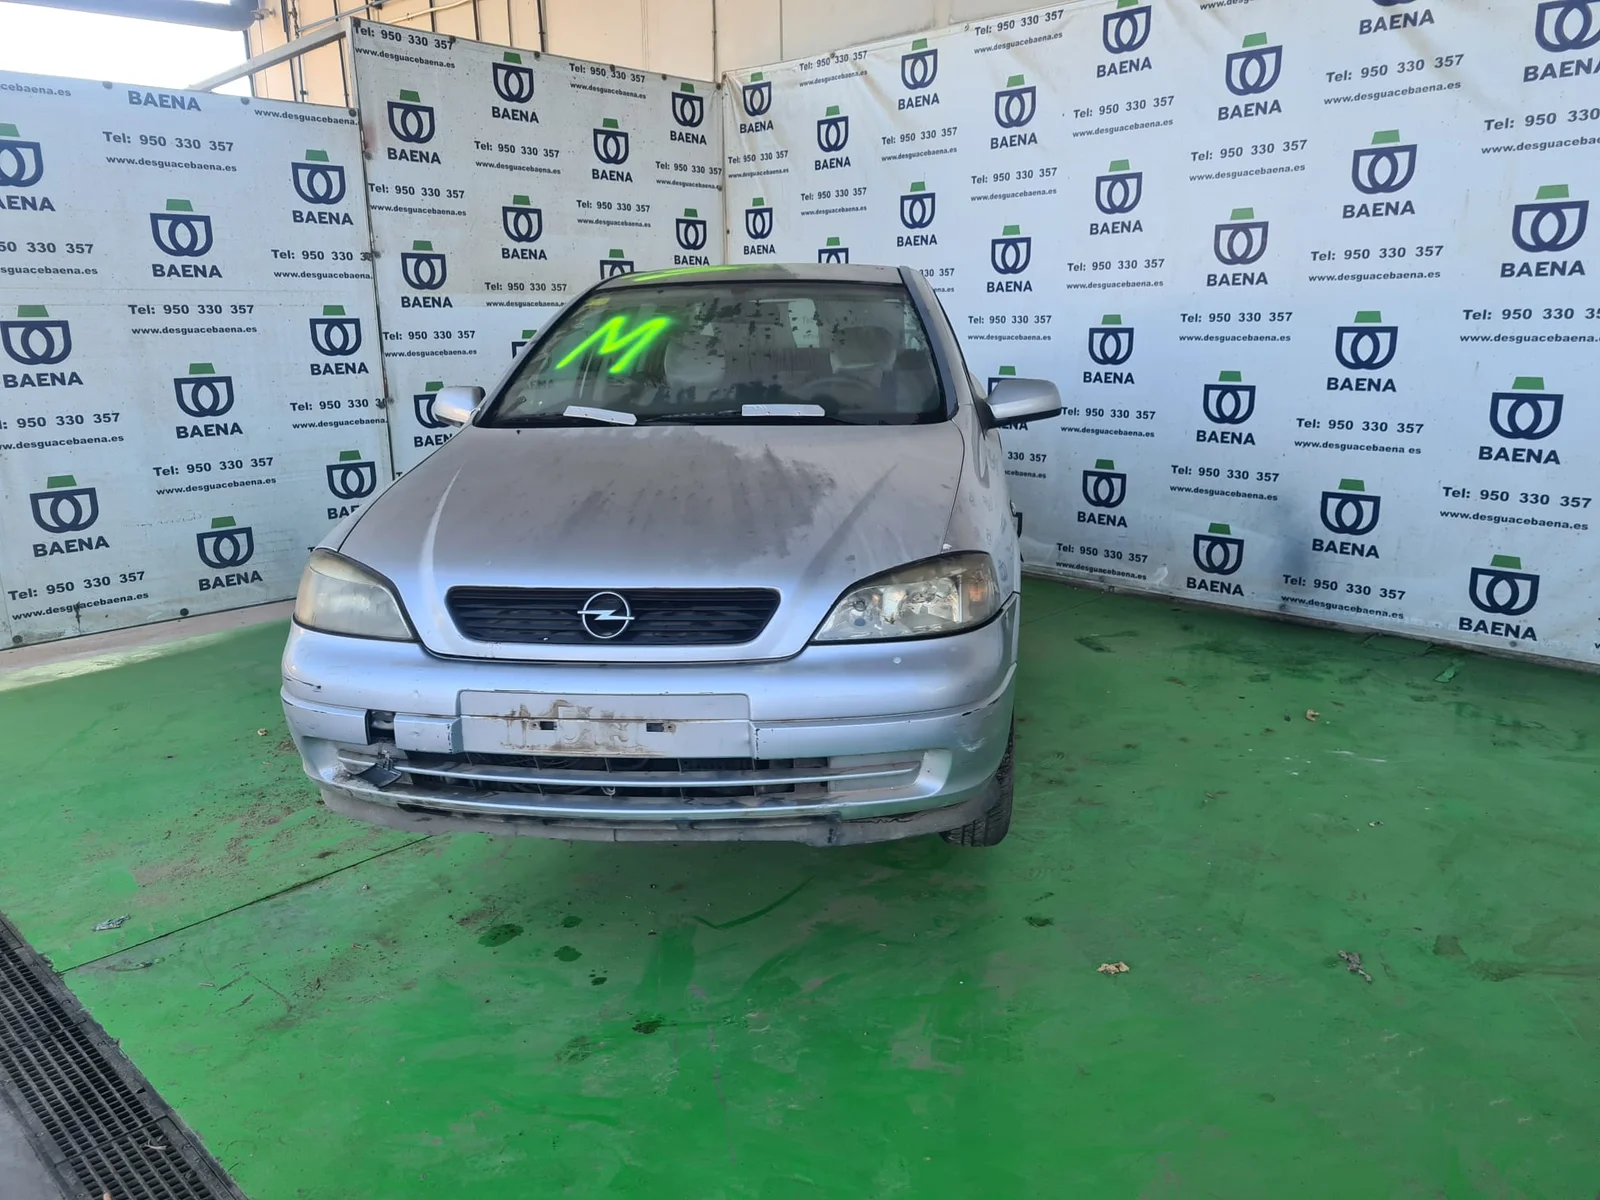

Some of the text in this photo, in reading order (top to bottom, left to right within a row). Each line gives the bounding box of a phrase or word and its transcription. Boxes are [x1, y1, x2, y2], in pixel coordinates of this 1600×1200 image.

[974, 9, 1064, 36] Tel: 950 330 357
[1359, 9, 1435, 35] BAENA
[974, 32, 1063, 54] www.desguacebaena.es
[355, 46, 456, 69] www.desguacebaena.es
[1097, 56, 1152, 78] BAENA
[1326, 54, 1464, 83] Tel: 950 330 357
[128, 90, 202, 112] BAENA
[1324, 82, 1461, 105] www.desguacebaena.es
[898, 93, 940, 111] BAENA
[1073, 95, 1174, 119] Tel: 950 330 357
[1218, 99, 1282, 121] BAENA
[492, 106, 539, 124] BAENA
[740, 120, 774, 134] BAENA
[1072, 119, 1173, 138] www.desguacebaena.es
[102, 131, 234, 152] Tel: 950 330 357
[670, 130, 707, 145] BAENA
[881, 127, 957, 145] Tel: 950 330 357
[990, 132, 1038, 150] BAENA
[387, 147, 441, 165] BAENA
[1191, 139, 1308, 162] Tel: 950 330 357
[106, 157, 237, 172] www.desguacebaena.es
[475, 161, 561, 175] www.desguacebaena.es
[815, 156, 851, 171] BAENA
[592, 168, 633, 183] BAENA
[1189, 165, 1305, 181] www.desguacebaena.es
[368, 182, 465, 199] Tel: 950 330 357
[800, 187, 867, 201] Tel: 950 330 357
[970, 189, 1057, 201] www.desguacebaena.es
[370, 202, 467, 216] www.desguacebaena.es
[576, 199, 650, 213] Tel: 950 330 357
[1342, 200, 1415, 219] BAENA
[292, 210, 354, 225] BAENA
[1090, 220, 1143, 235] BAENA
[897, 234, 937, 247] BAENA
[501, 248, 547, 260] BAENA
[743, 244, 776, 255] BAENA
[1311, 245, 1444, 261] Tel: 950 330 357
[674, 255, 710, 266] BAENA
[152, 264, 223, 278] BAENA
[1308, 271, 1441, 282] www.desguacebaena.es
[1500, 260, 1585, 278] BAENA
[987, 280, 1033, 293] BAENA
[1066, 280, 1164, 290] www.desguacebaena.es
[1206, 272, 1268, 287] BAENA
[128, 304, 254, 315] Tel: 950 330 357
[401, 296, 453, 308] BAENA
[968, 315, 1052, 324] Tel: 950 330 357
[1180, 312, 1293, 323] Tel: 950 330 357
[131, 326, 257, 335] www.desguacebaena.es
[382, 330, 475, 341] Tel: 950 330 357
[968, 334, 1051, 342] www.desguacebaena.es
[1179, 334, 1291, 343] www.desguacebaena.es
[384, 348, 477, 358] www.desguacebaena.es
[310, 362, 369, 376] BAENA
[2, 371, 84, 388] BAENA
[1083, 371, 1135, 384] BAENA
[1327, 377, 1397, 392] BAENA
[1061, 407, 1156, 420] Tel: 950 330 357
[176, 422, 243, 439] BAENA
[1061, 426, 1155, 437] www.desguacebaena.es
[1296, 418, 1424, 434] Tel: 950 330 357
[1196, 430, 1256, 445] BAENA
[1478, 446, 1560, 465] BAENA
[153, 457, 273, 476] Tel: 950 330 357
[1171, 465, 1280, 482] Tel: 950 330 357
[156, 478, 276, 495] www.desguacebaena.es
[1170, 486, 1278, 501] www.desguacebaena.es
[1442, 486, 1592, 508] Tel: 950 330 357
[1077, 511, 1128, 528] BAENA
[1440, 511, 1588, 530] www.desguacebaena.es
[32, 536, 110, 557] BAENA
[1056, 542, 1148, 563] Tel: 950 330 357
[1312, 538, 1379, 559] BAENA
[1055, 561, 1147, 580] www.desguacebaena.es
[7, 571, 145, 601] Tel: 950 330 357
[198, 570, 263, 591] BAENA
[1186, 577, 1244, 597] BAENA
[1282, 574, 1406, 600] Tel: 950 330 357
[1281, 596, 1404, 619] www.desguacebaena.es
[1459, 617, 1537, 641] BAENA
